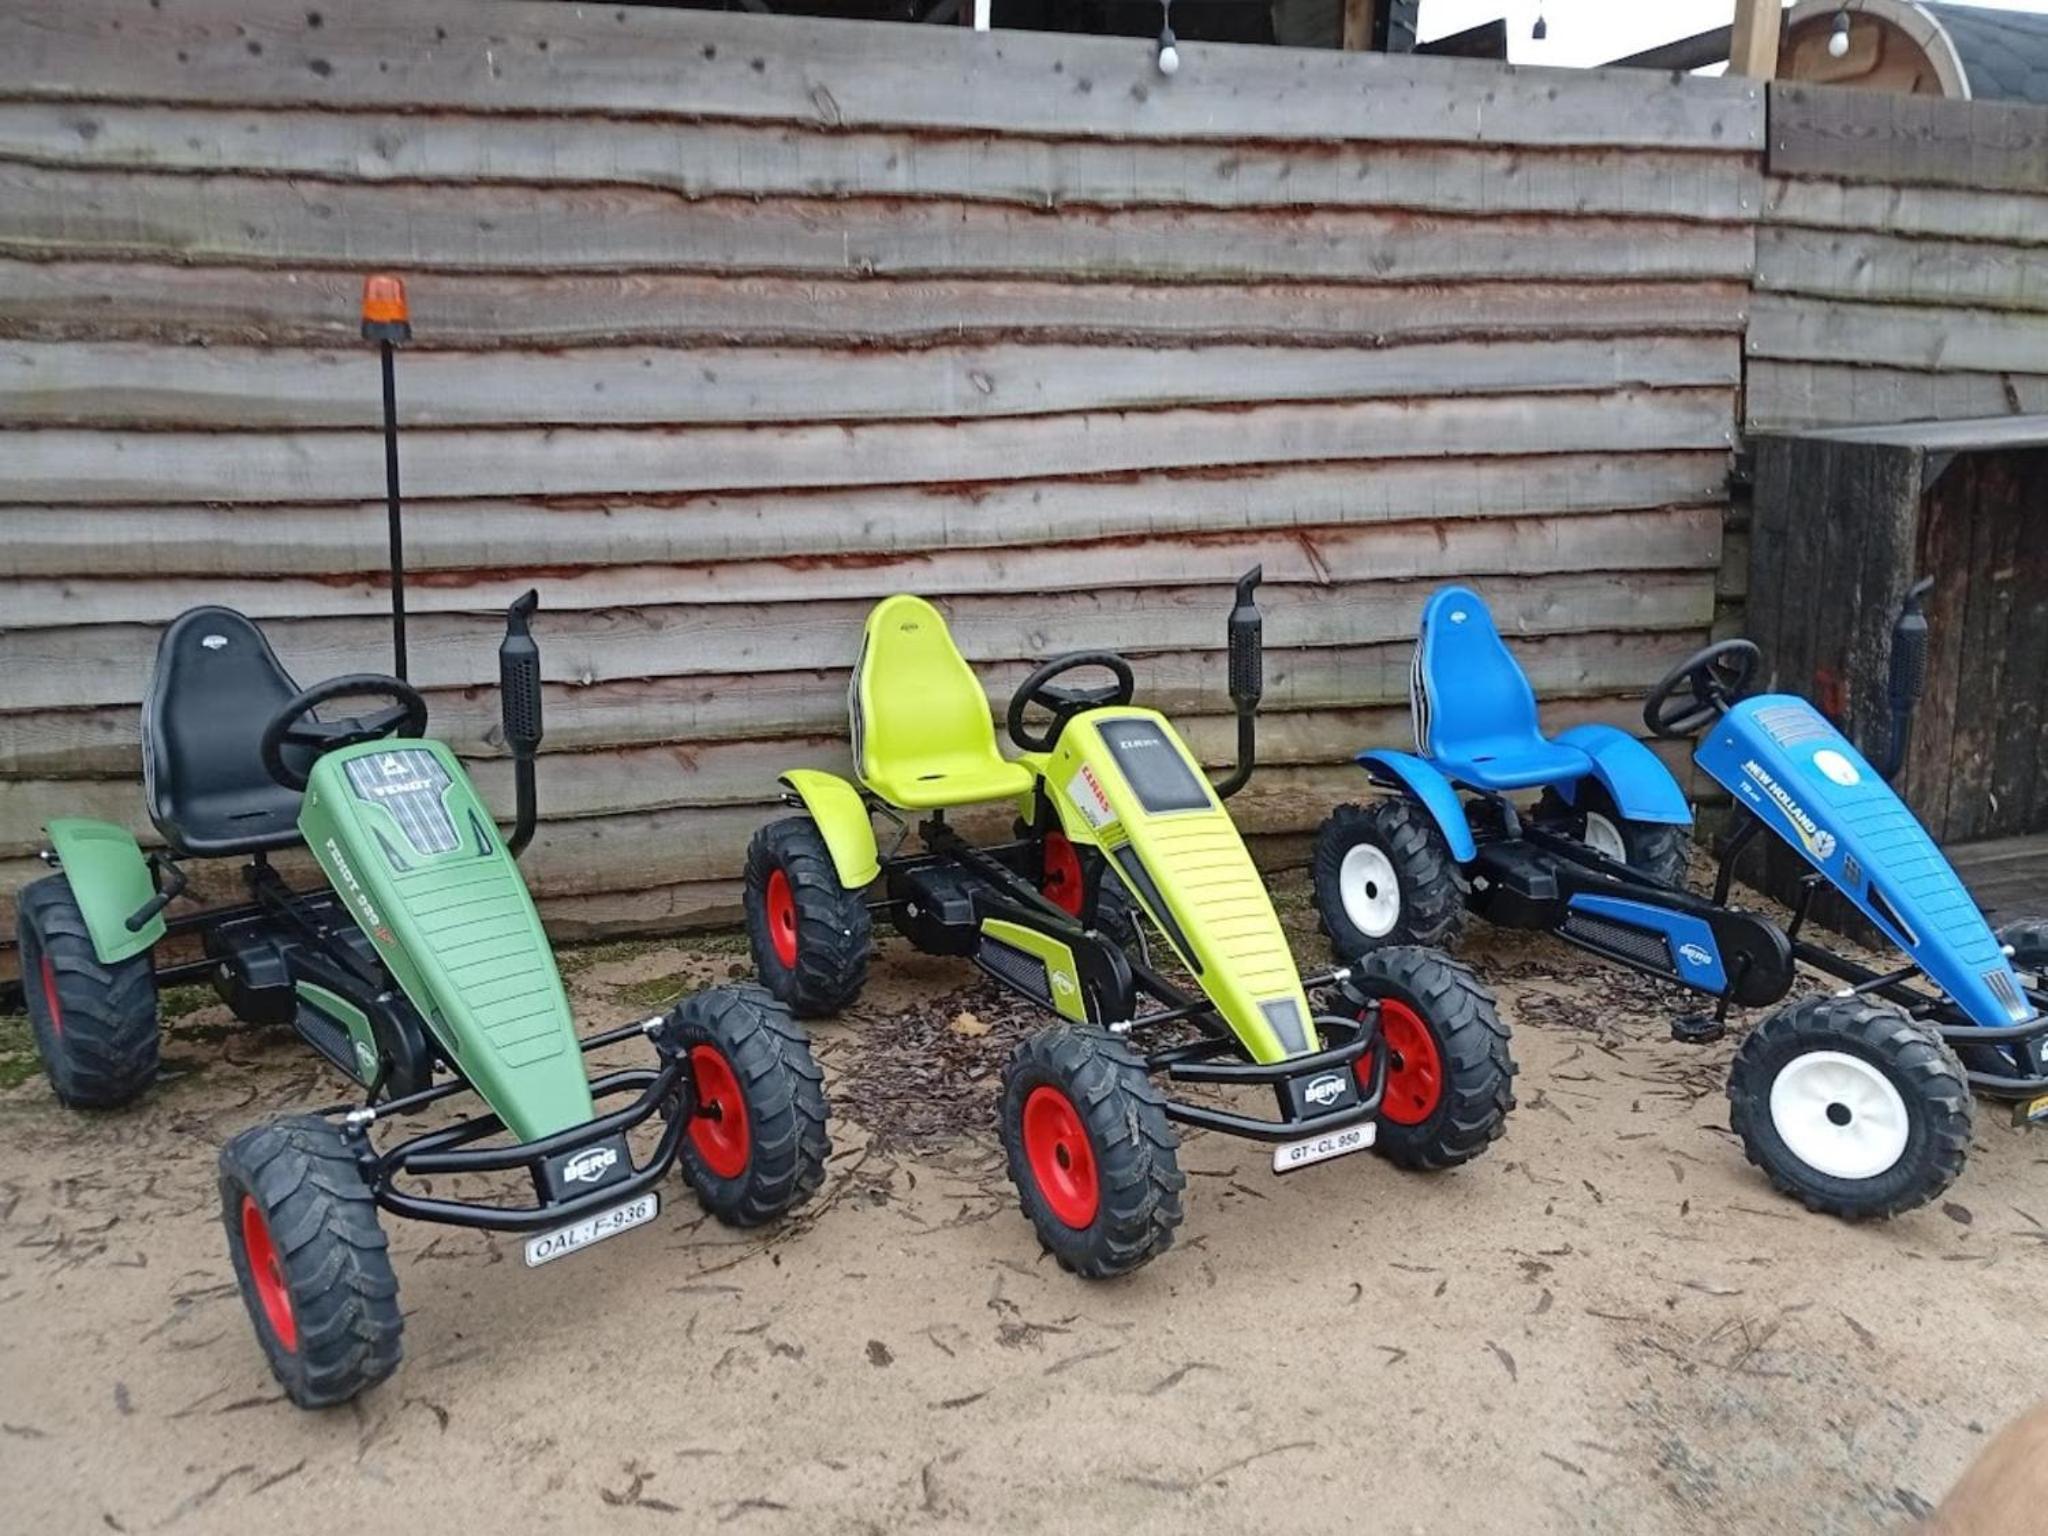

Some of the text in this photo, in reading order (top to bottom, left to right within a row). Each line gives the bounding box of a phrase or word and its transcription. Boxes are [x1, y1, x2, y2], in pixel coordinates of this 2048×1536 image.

[1745, 760, 1774, 787] NEW
[1769, 781, 1817, 834] HOLLAND
[1305, 1076, 1346, 1104] BERG
[564, 1148, 618, 1182] BERG
